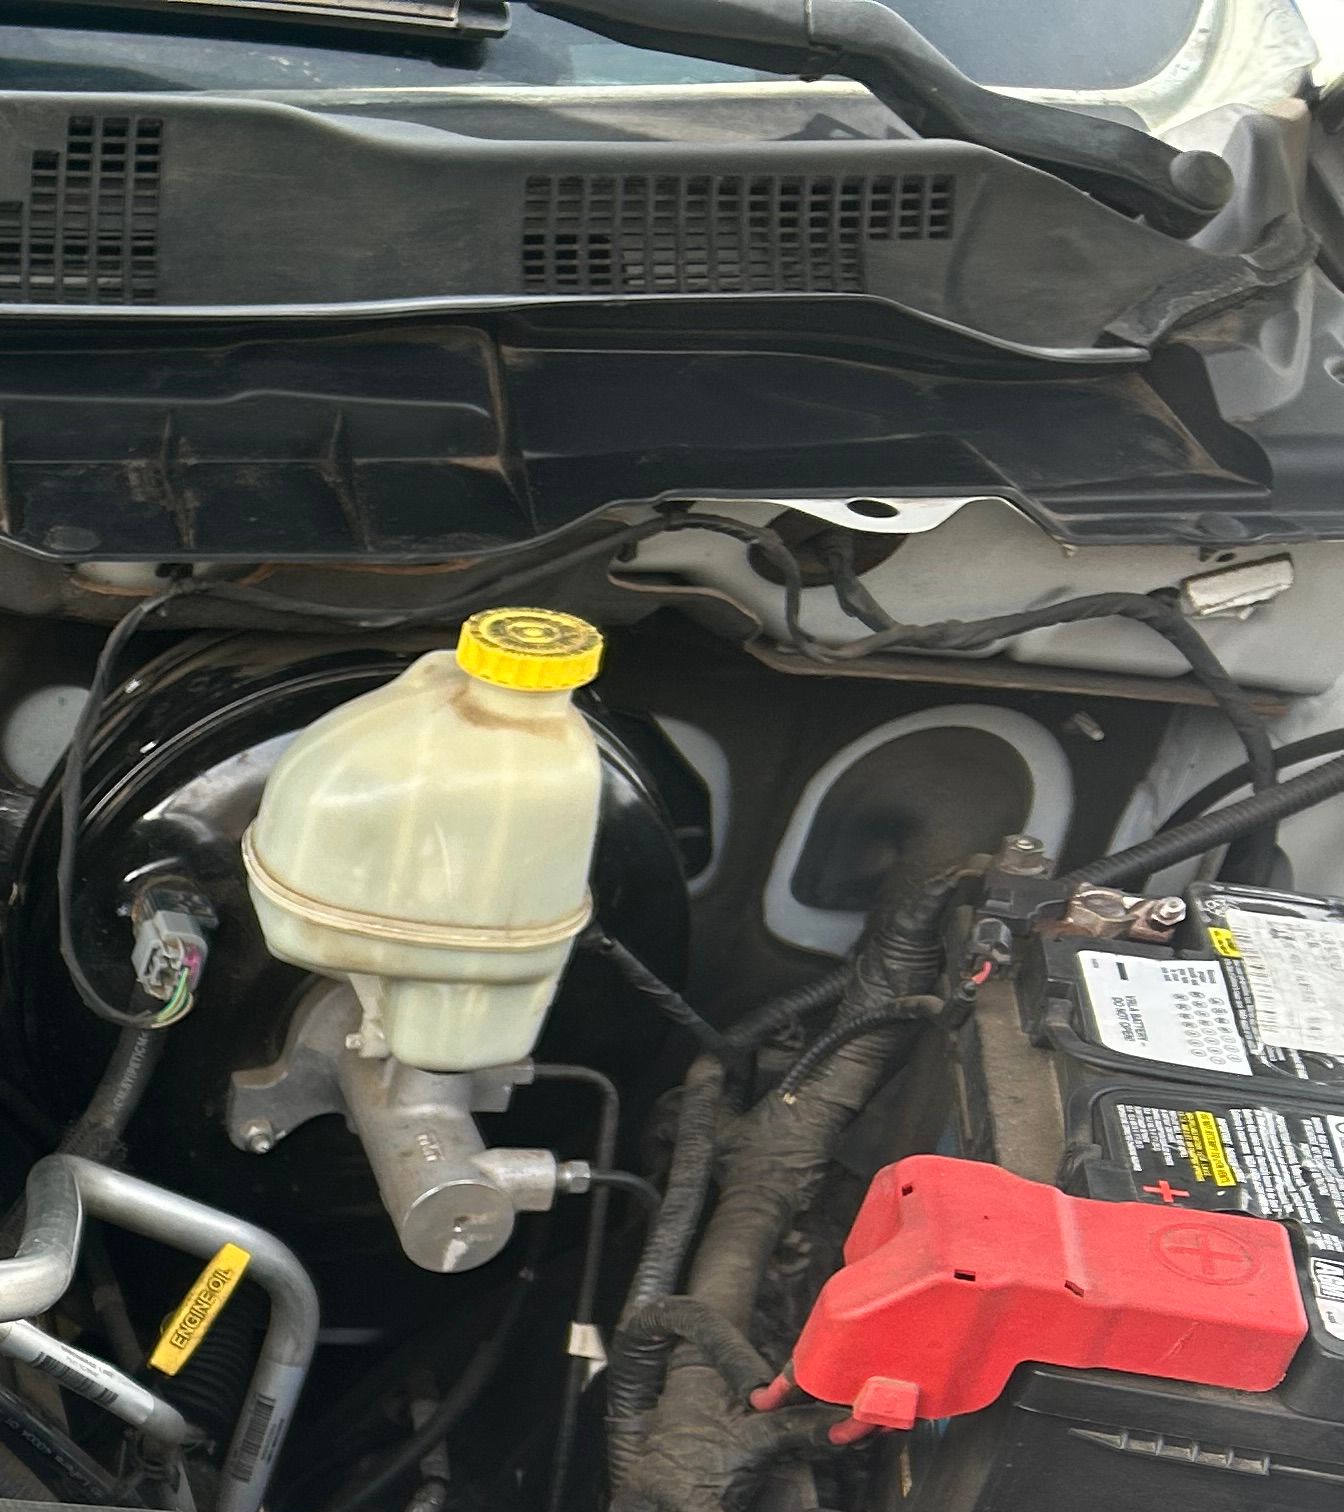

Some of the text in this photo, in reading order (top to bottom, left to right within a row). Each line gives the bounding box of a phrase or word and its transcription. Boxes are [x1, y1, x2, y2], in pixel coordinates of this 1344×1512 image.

[1116, 1008, 1129, 1025] NOT
[1130, 1013, 1149, 1042] BATTERY
[169, 1268, 234, 1350] ENGINE OIL
